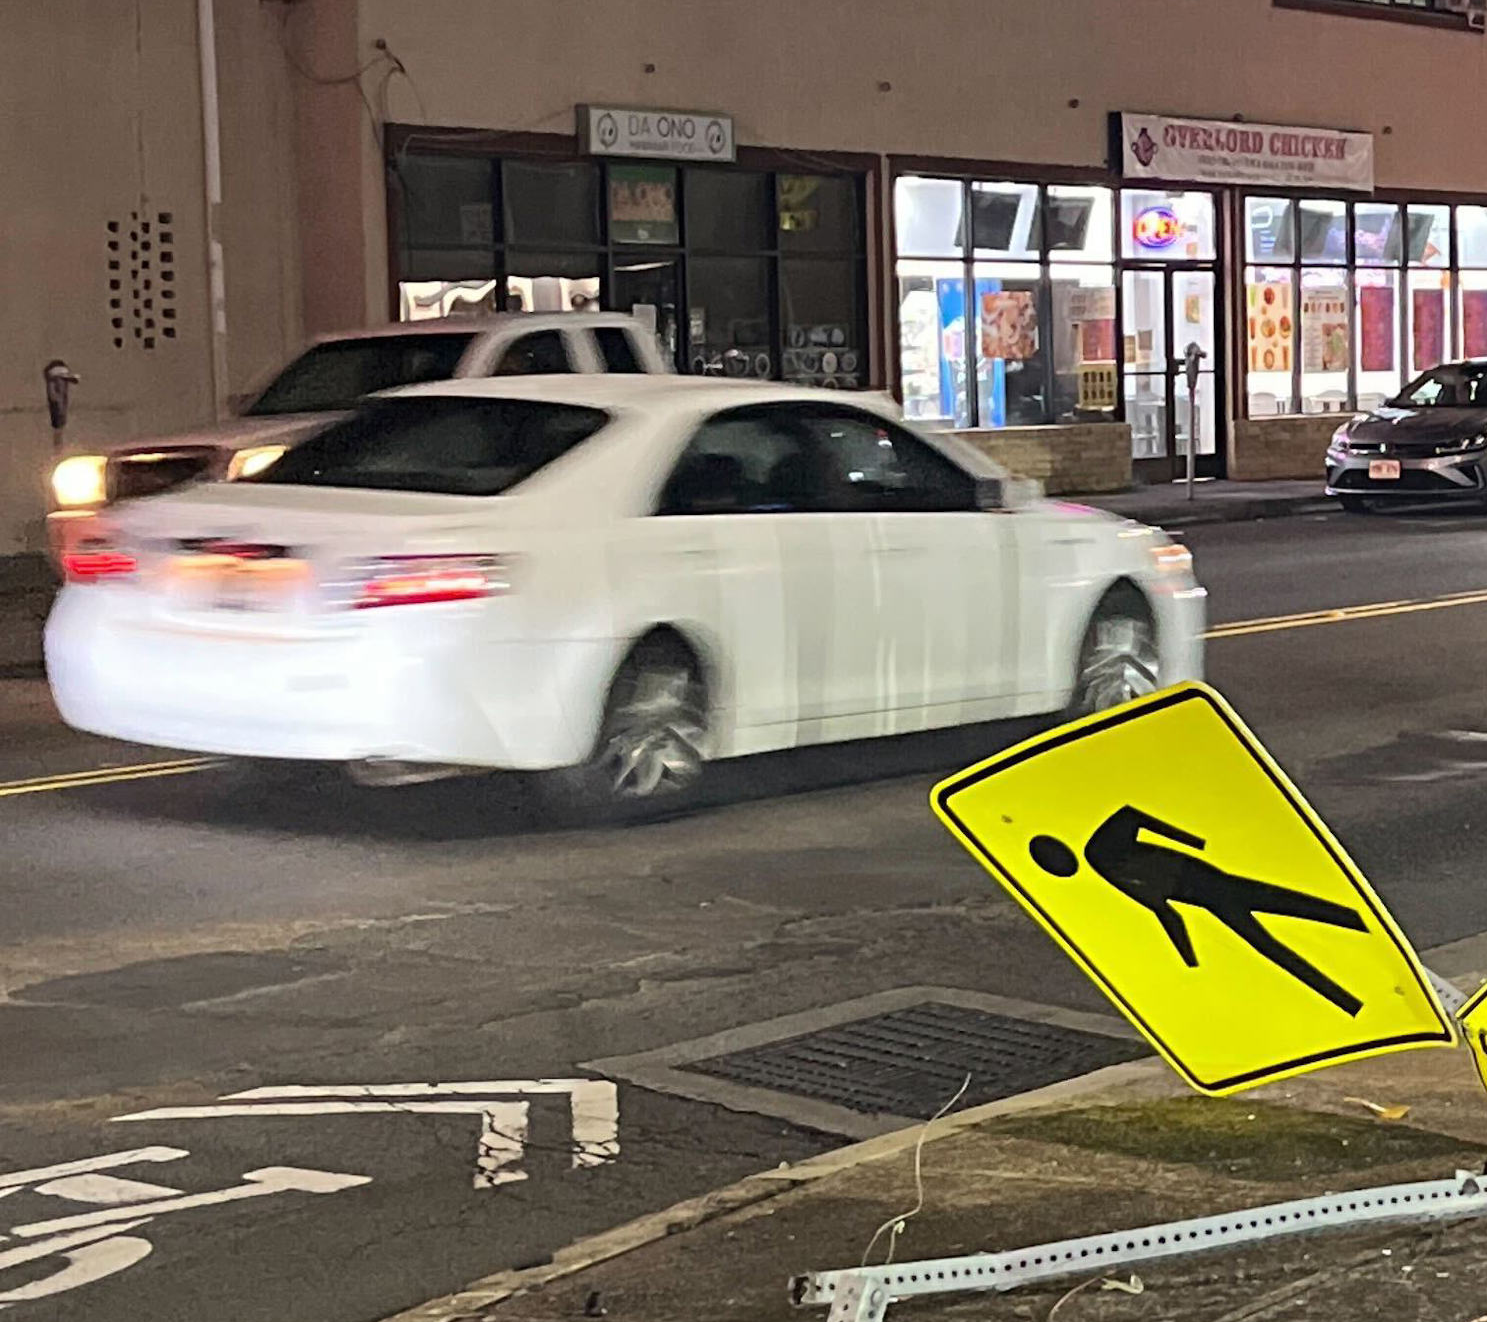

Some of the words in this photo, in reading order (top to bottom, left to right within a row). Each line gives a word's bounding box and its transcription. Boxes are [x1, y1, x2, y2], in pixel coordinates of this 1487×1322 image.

[627, 114, 650, 137] DA
[656, 116, 696, 140] ONO
[1162, 124, 1264, 155] OVERLORD
[1268, 132, 1348, 161] CHICKEN
